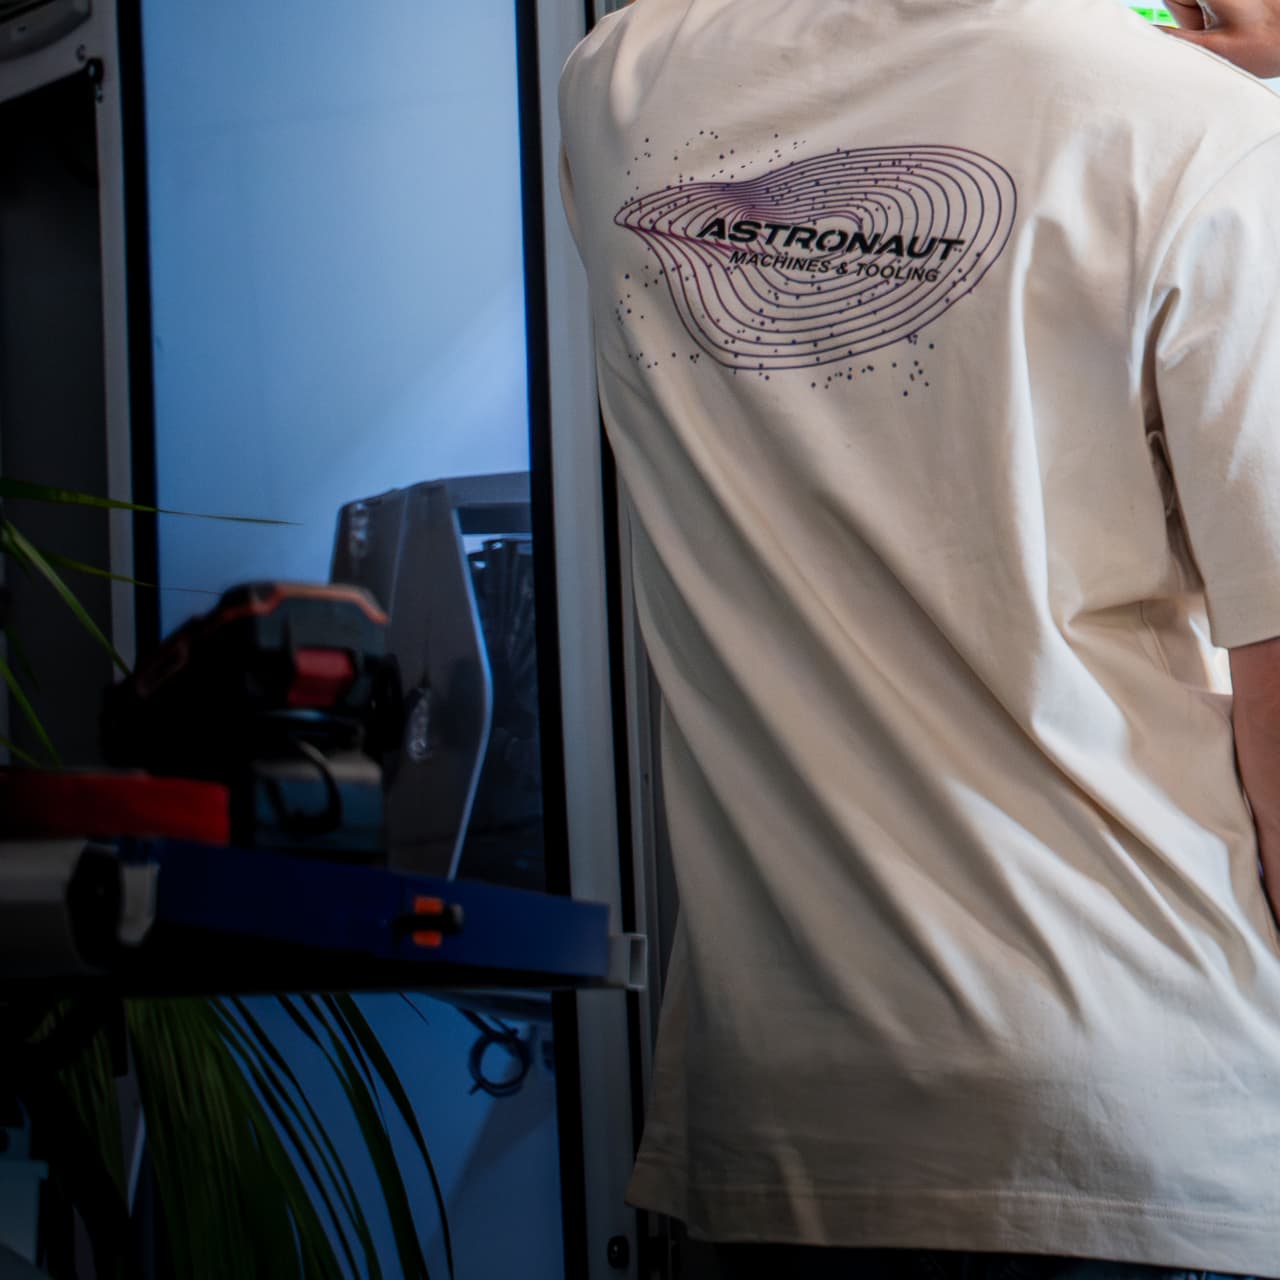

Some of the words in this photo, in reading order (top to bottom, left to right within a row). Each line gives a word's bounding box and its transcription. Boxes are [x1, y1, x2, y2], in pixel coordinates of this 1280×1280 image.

[696, 217, 966, 261] ASTRONAUT
[729, 250, 832, 275] MACHINES
[835, 261, 851, 276] &
[856, 262, 941, 283] TOOLING
